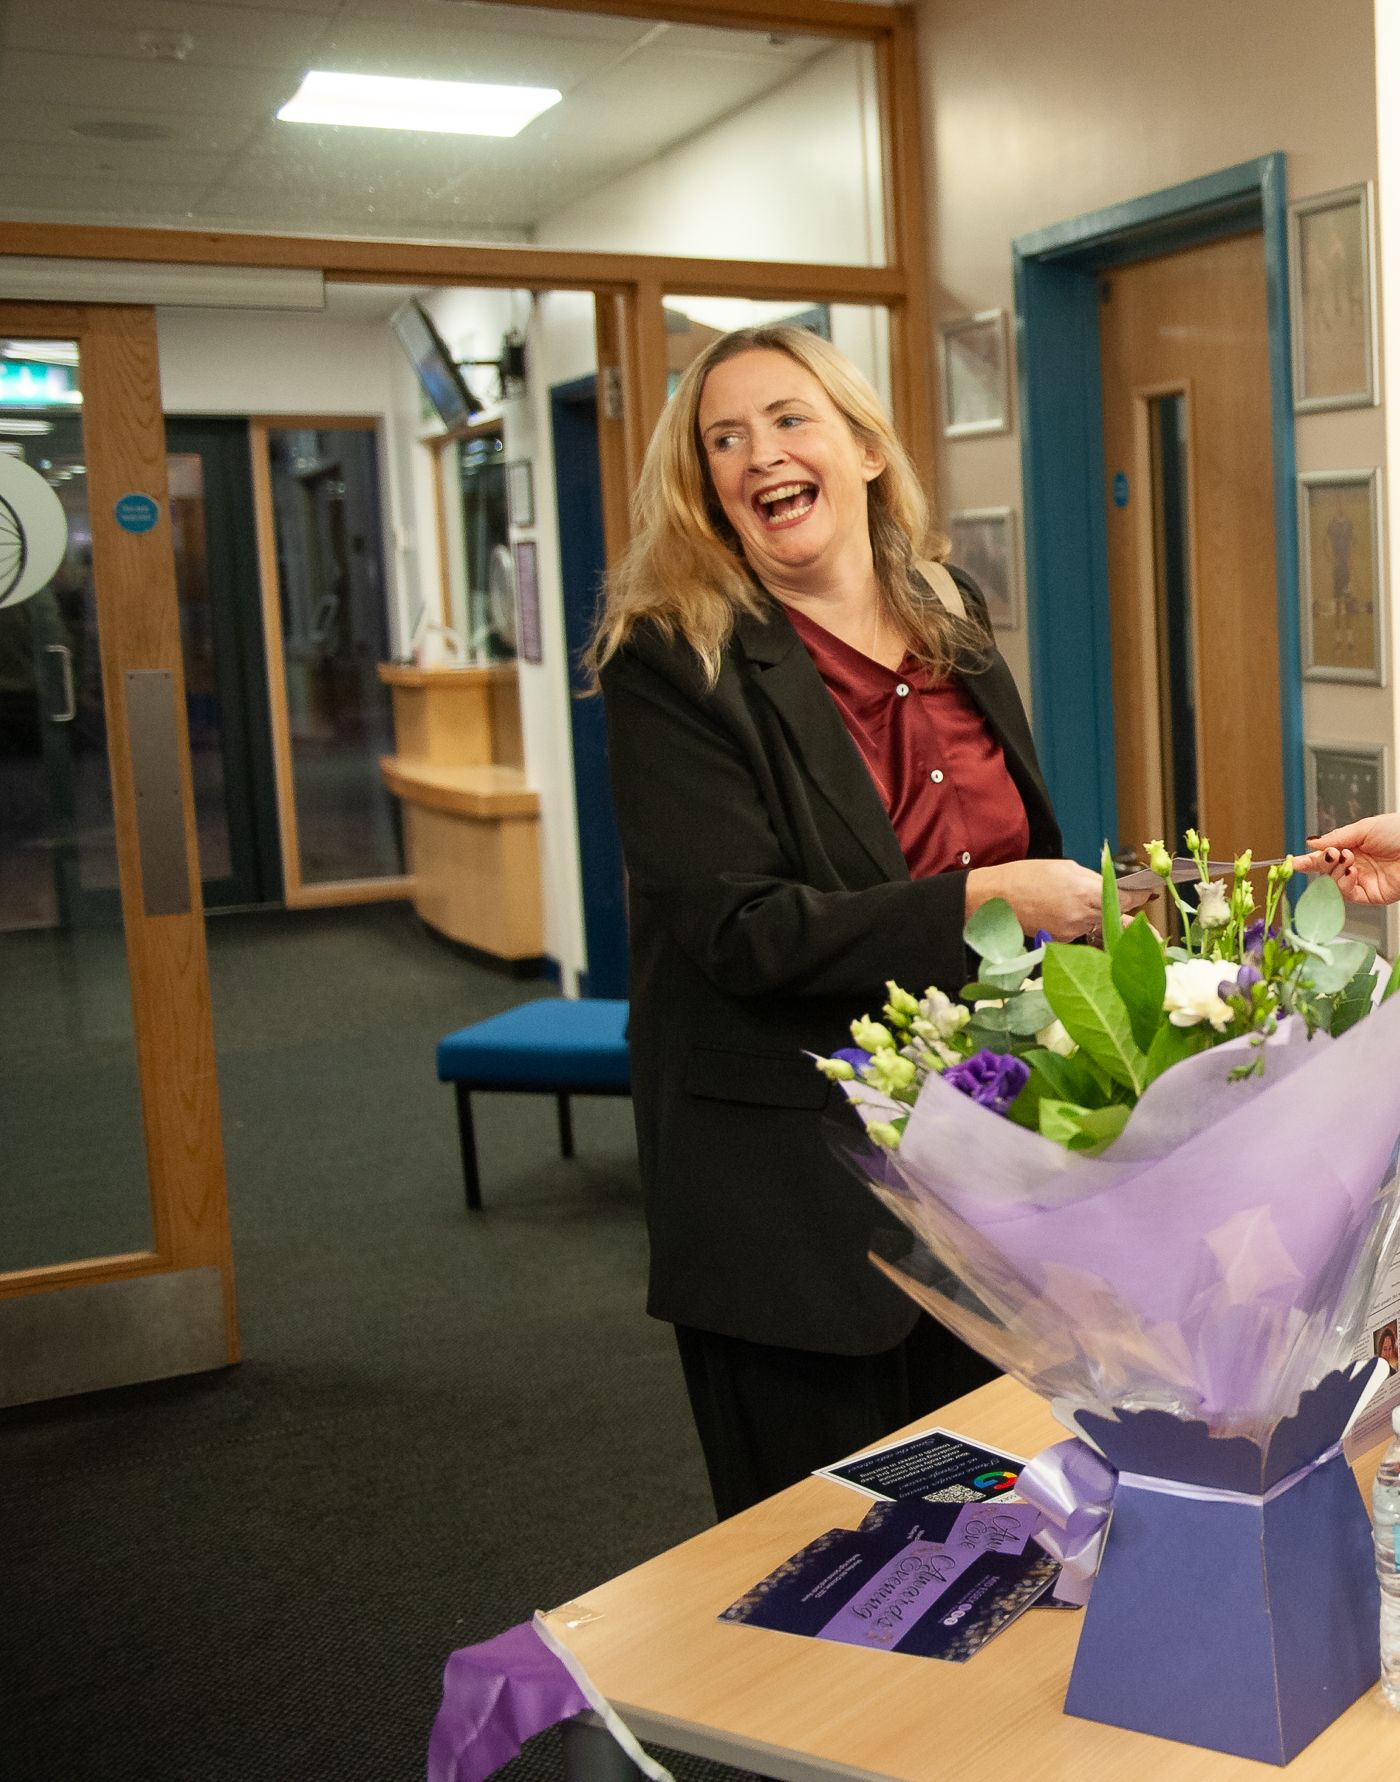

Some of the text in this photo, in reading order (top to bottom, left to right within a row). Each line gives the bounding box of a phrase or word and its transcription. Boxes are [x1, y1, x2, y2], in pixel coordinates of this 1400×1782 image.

[924, 1443, 950, 1455] towards
[926, 1443, 963, 1459] considering
[934, 1457, 955, 1467] words
[878, 1468, 908, 1482] someone
[881, 1469, 920, 1486] experiences
[851, 1556, 932, 1619] Evening
[877, 1554, 956, 1628] Awards
